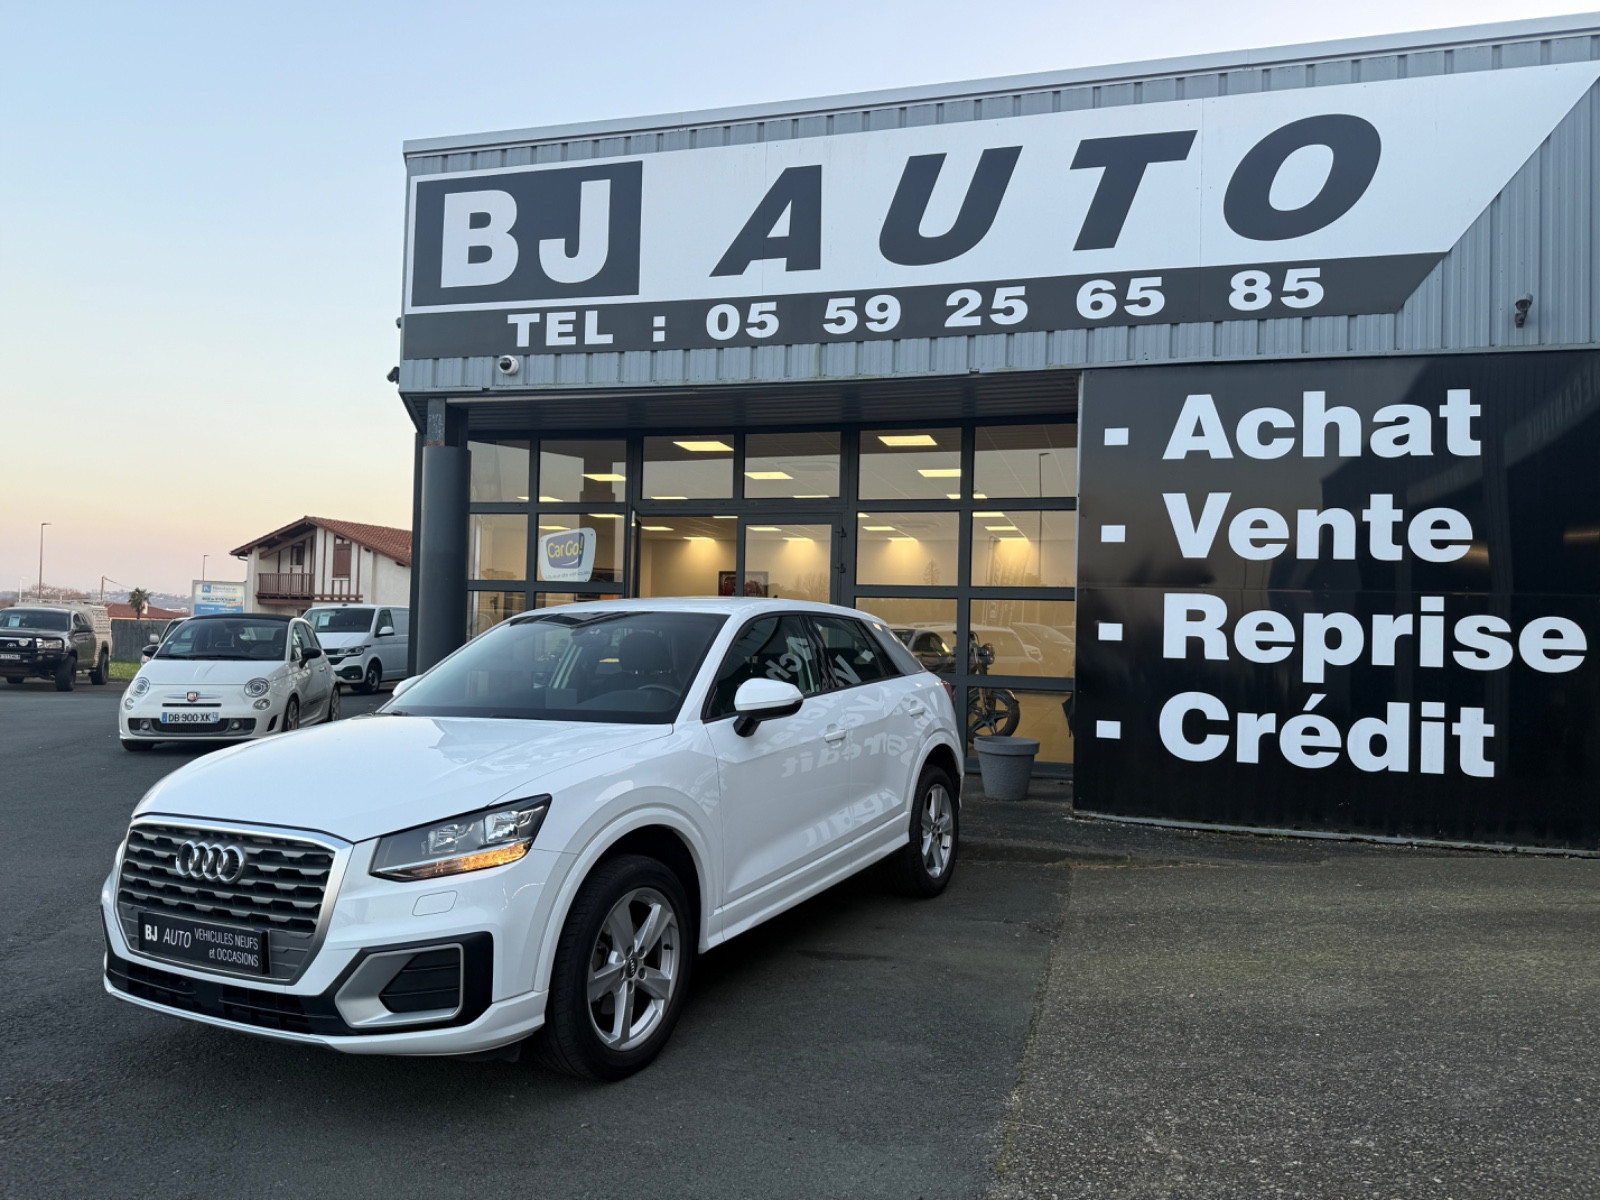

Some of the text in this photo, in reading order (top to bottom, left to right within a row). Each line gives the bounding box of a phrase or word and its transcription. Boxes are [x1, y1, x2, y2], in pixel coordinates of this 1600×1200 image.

[441, 114, 1381, 288] BJ AUTO
[508, 311, 613, 347] TEL
[707, 302, 779, 340] 05
[823, 295, 900, 334] 59
[945, 286, 1028, 327] 25
[1077, 277, 1164, 319] 65
[1229, 268, 1323, 310] 85
[1162, 389, 1481, 459] Achat
[1163, 492, 1472, 562] Vente
[1163, 593, 1587, 683] Reprise
[1159, 692, 1494, 777] Crédit
[145, 924, 192, 948] BJ AUTO
[216, 948, 259, 967] OCCASIONS
[235, 934, 259, 951] NEUFS
